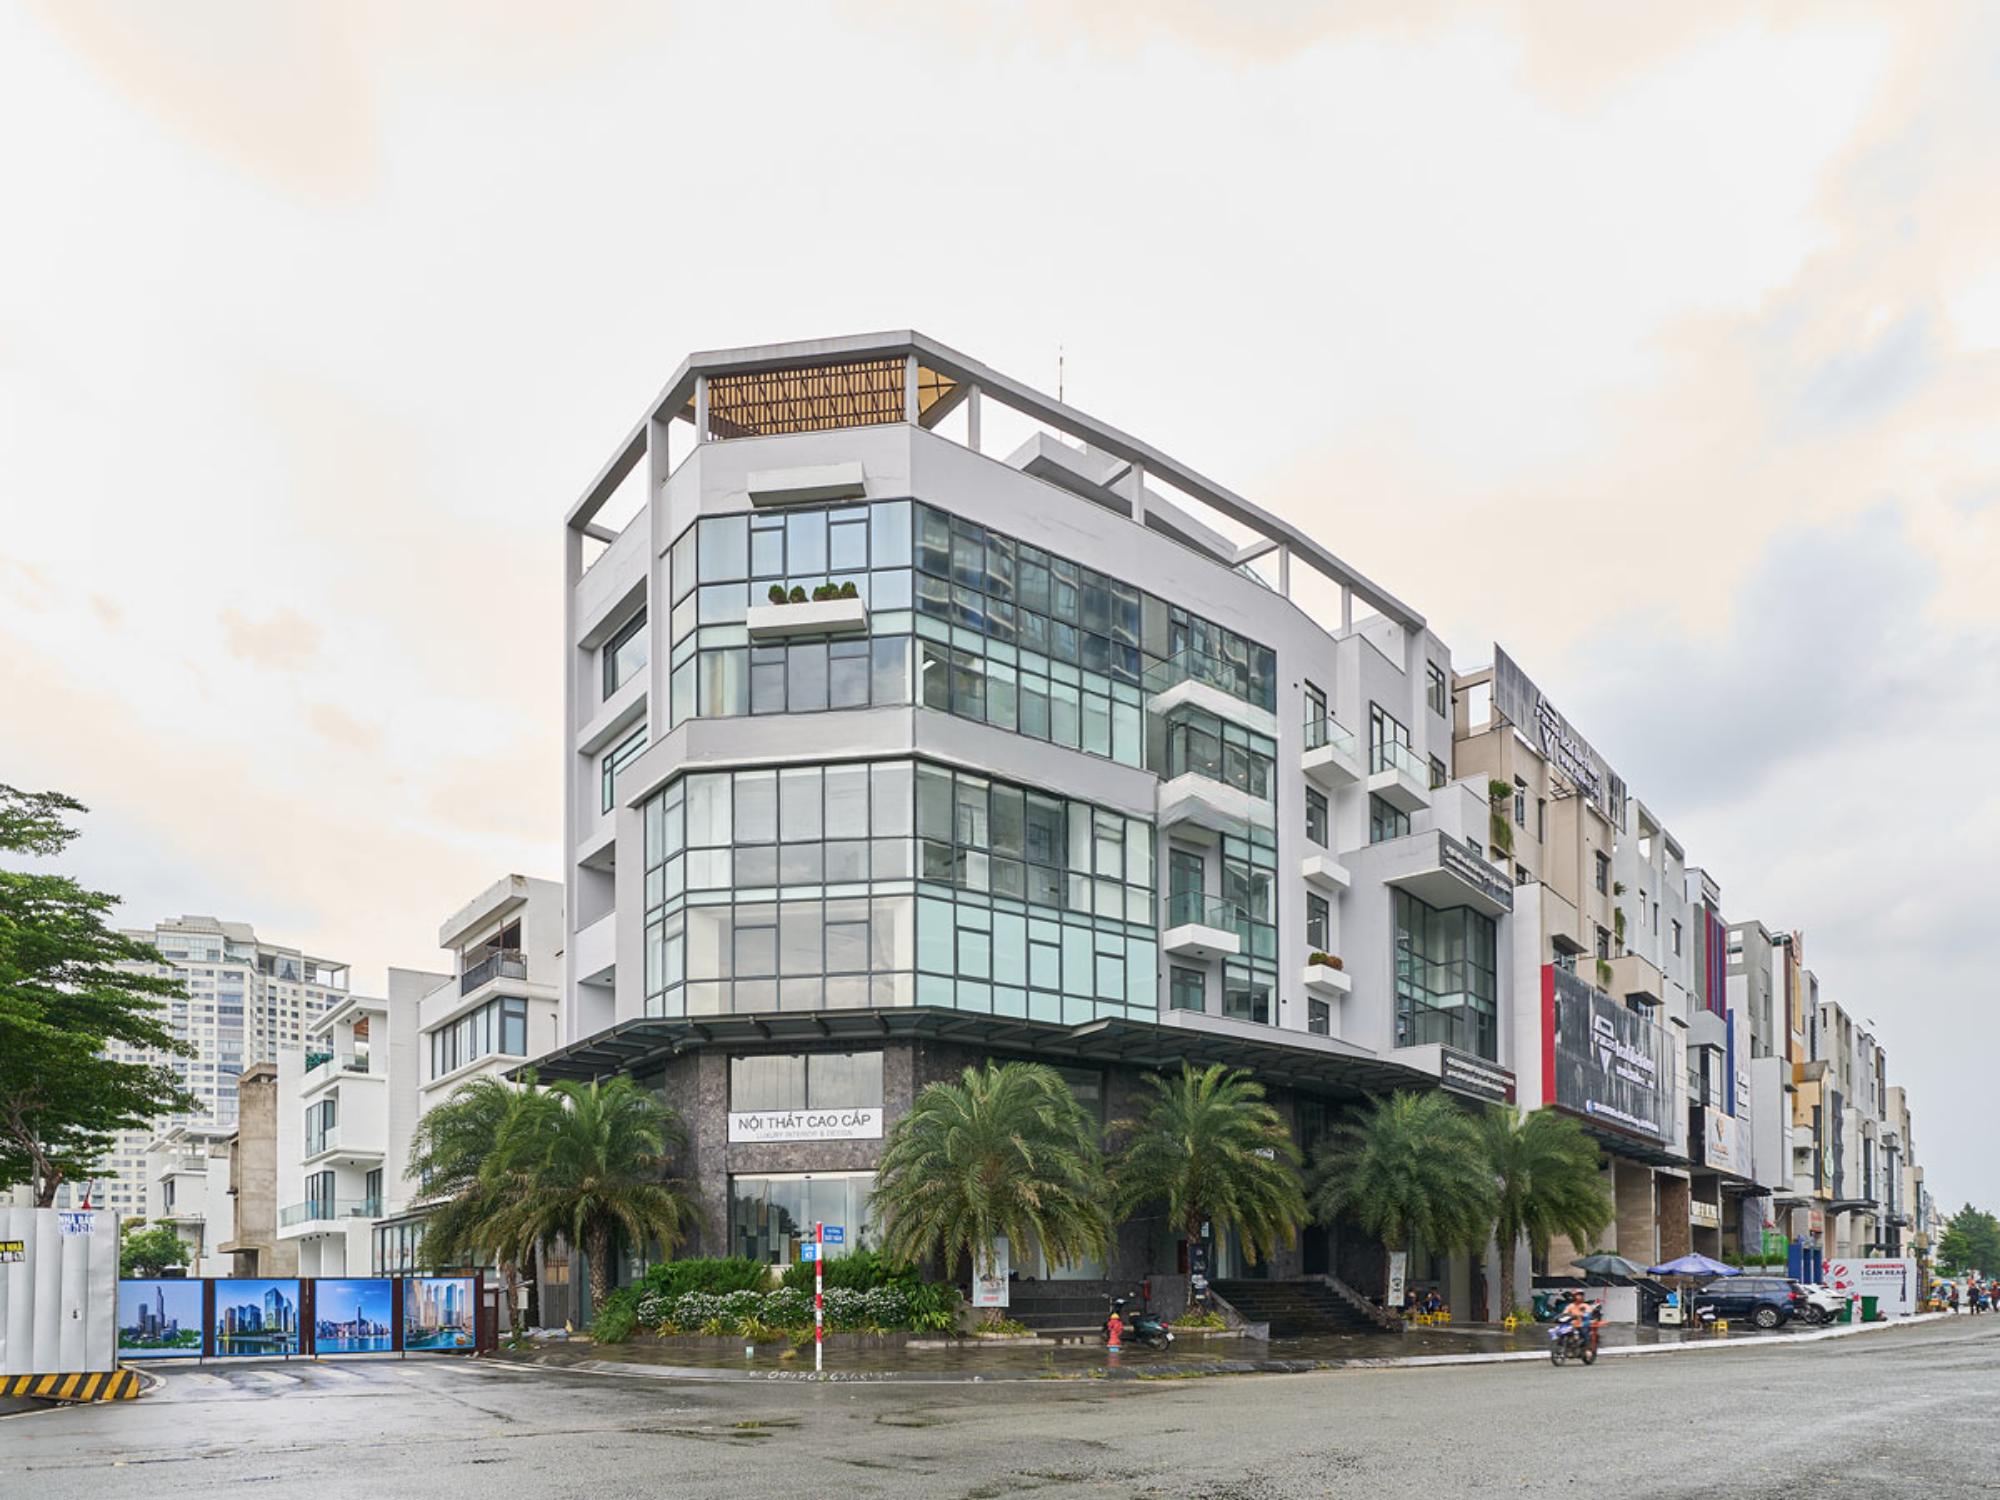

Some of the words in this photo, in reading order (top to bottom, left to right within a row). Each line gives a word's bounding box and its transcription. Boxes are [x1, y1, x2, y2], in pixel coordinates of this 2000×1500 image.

[738, 1115, 763, 1132] NỘI
[767, 1111, 804, 1129] THẤT
[807, 1115, 838, 1128] CAO
[841, 1110, 871, 1127] CẤP
[827, 1129, 853, 1137] DESIGN
